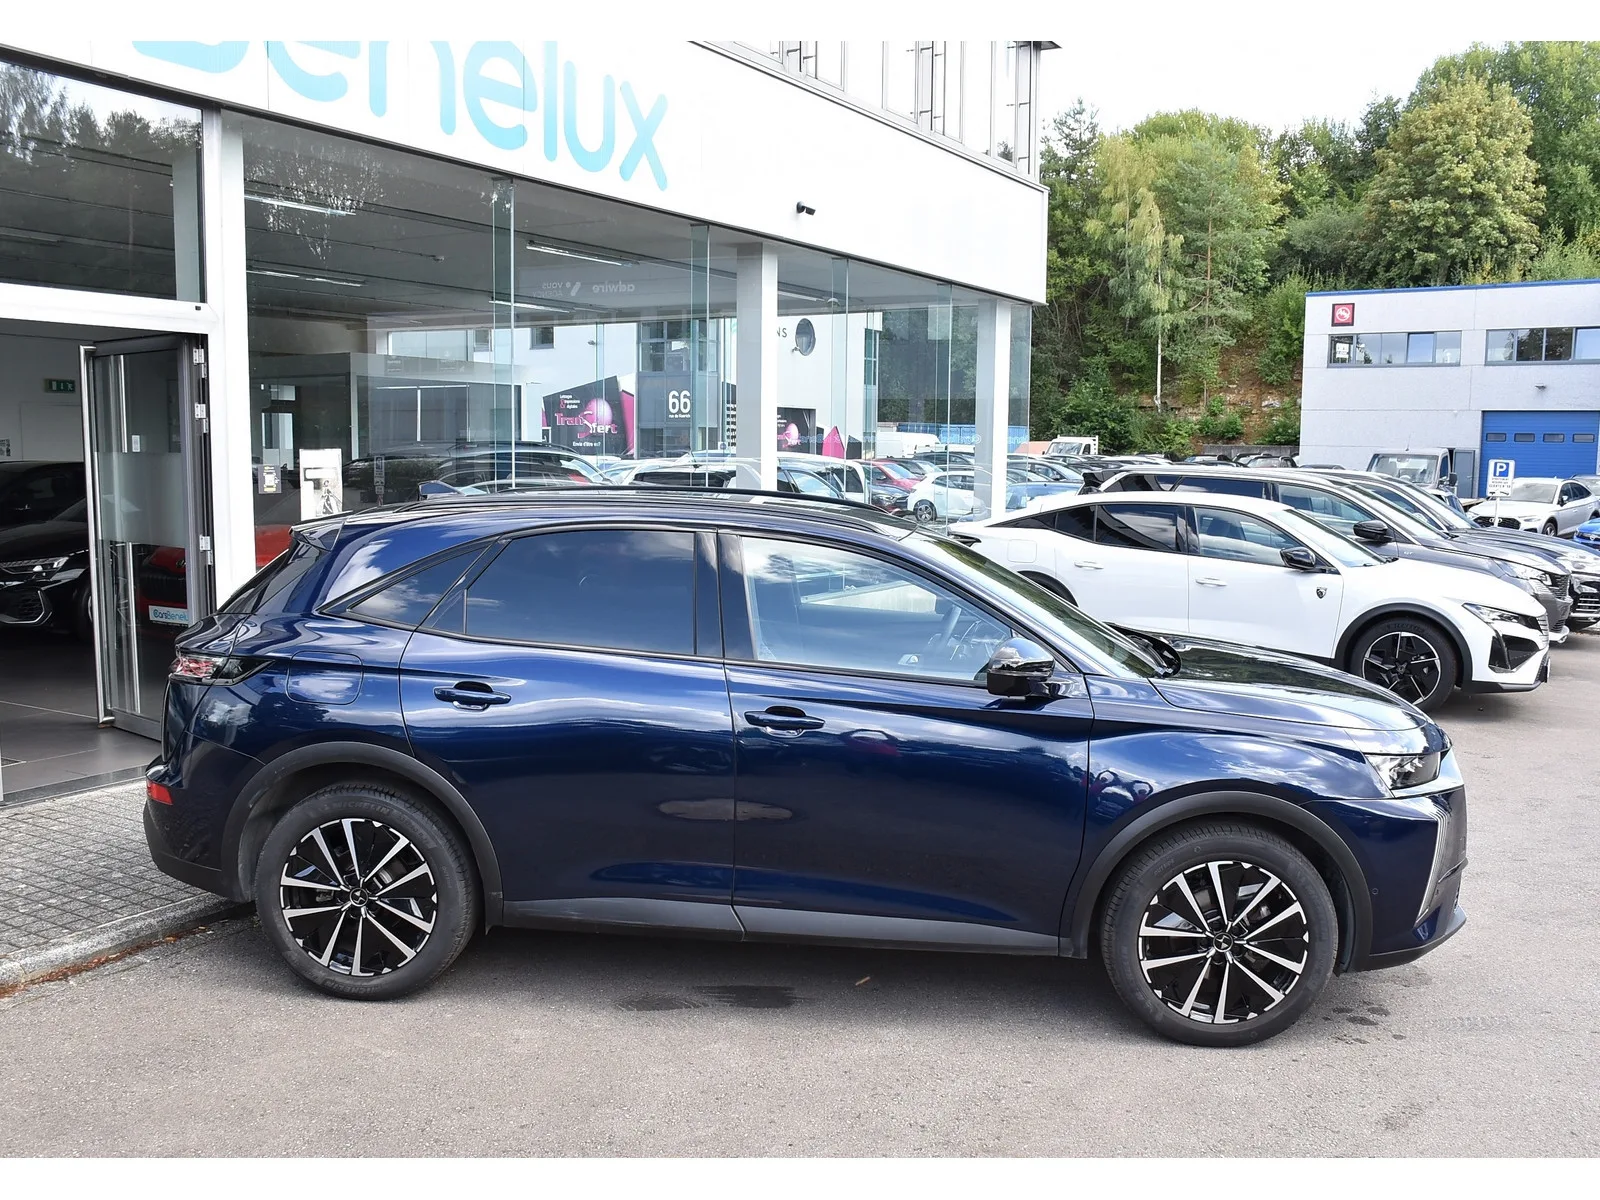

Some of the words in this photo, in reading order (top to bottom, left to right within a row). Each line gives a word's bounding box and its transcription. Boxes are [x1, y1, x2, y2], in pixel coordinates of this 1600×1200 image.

[131, 40, 668, 191] enelux
[669, 390, 690, 414] 66
[1496, 462, 1507, 476] P
